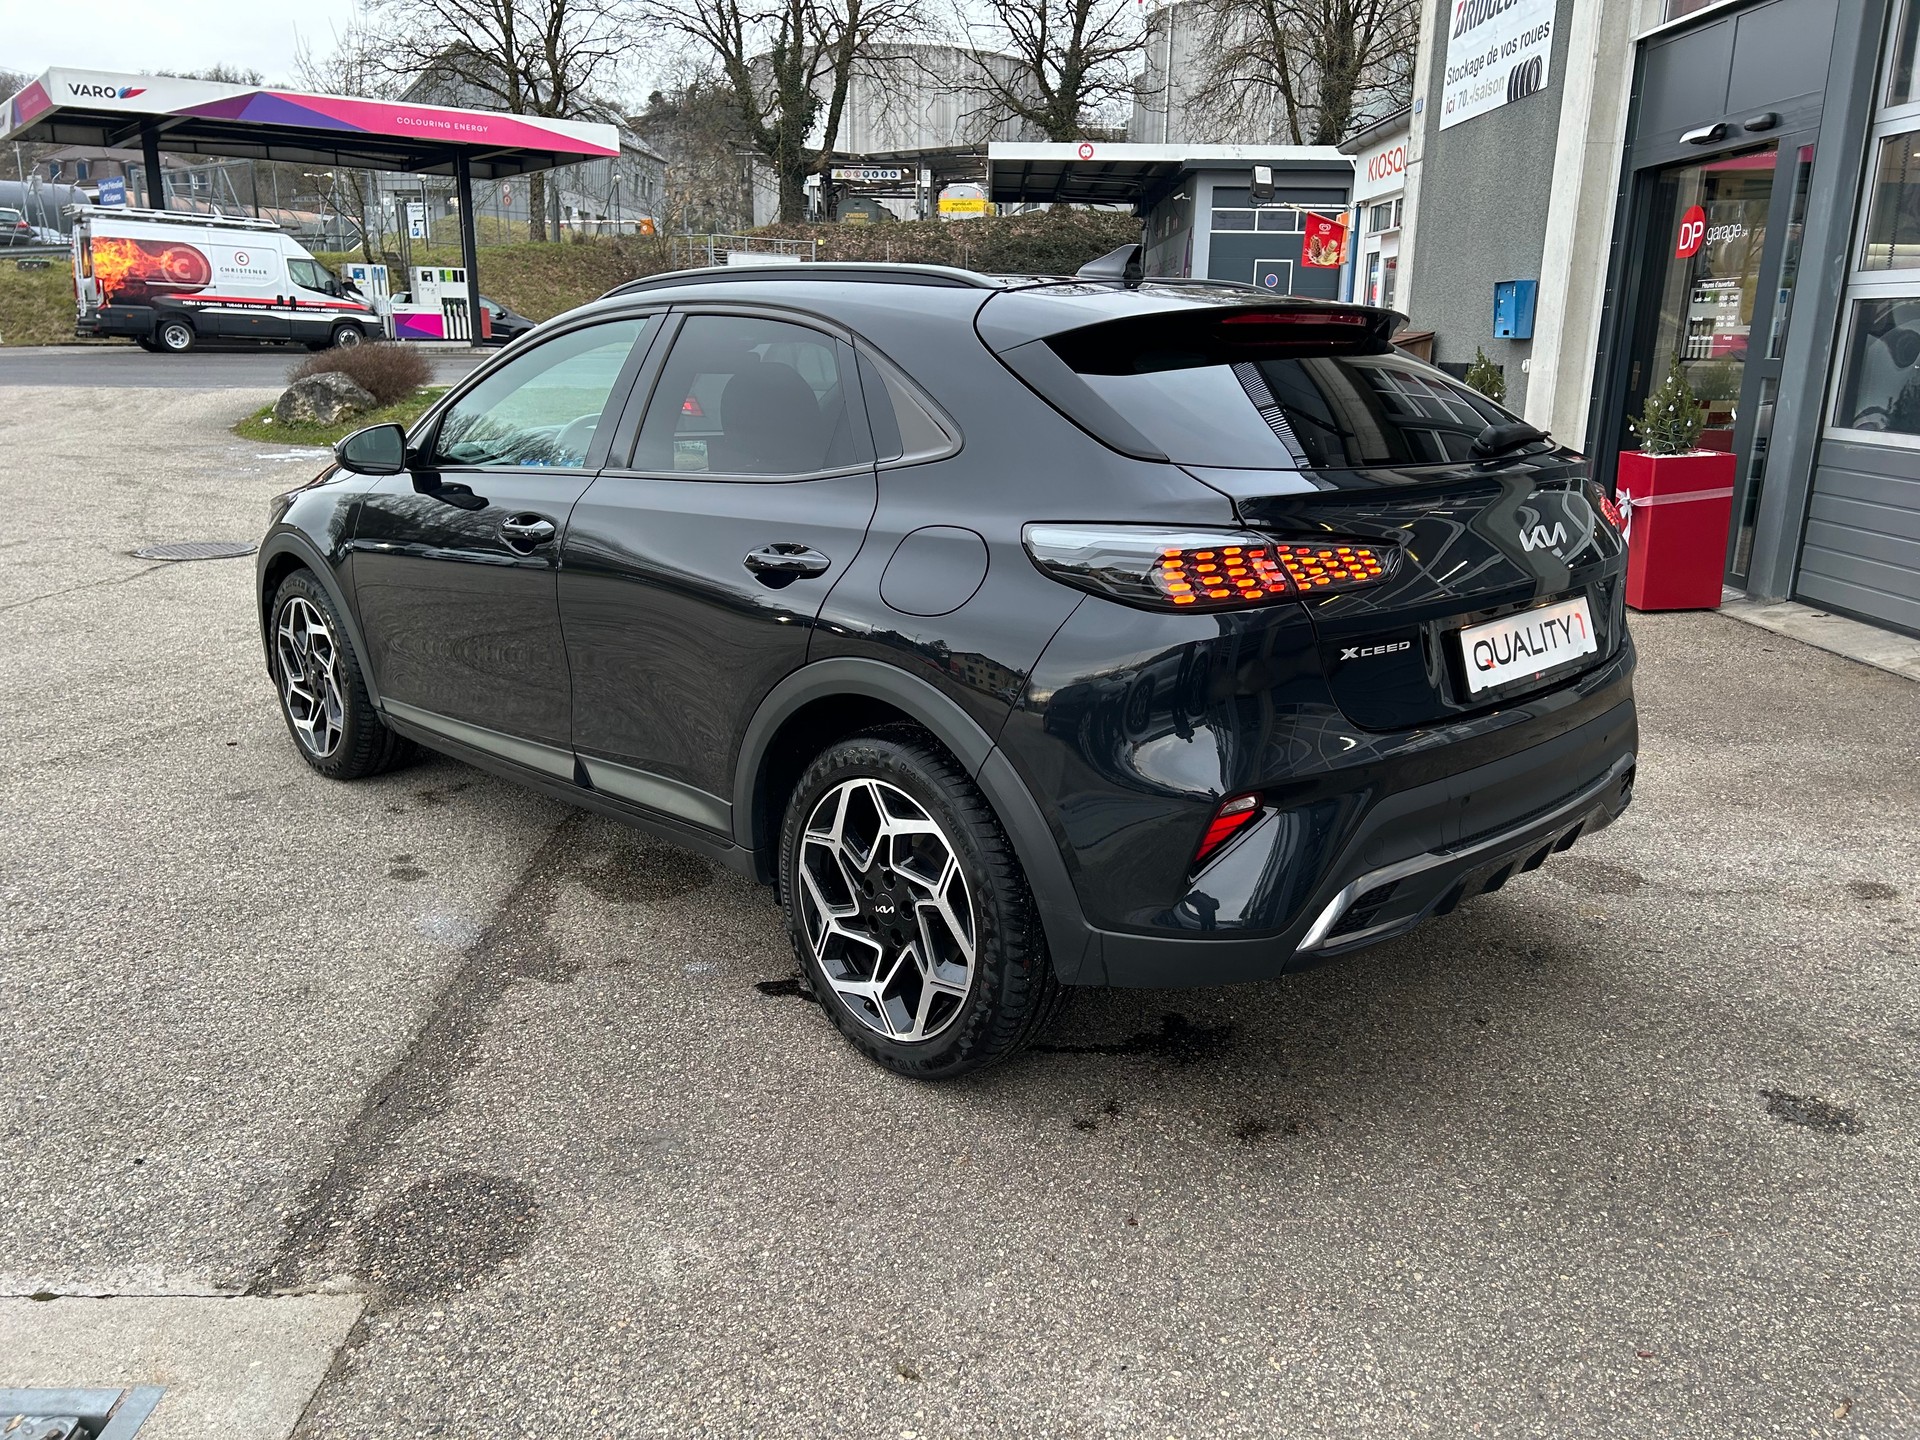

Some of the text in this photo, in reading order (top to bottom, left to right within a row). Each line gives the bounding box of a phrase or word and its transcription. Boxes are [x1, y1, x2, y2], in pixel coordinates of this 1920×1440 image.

[1446, 21, 1551, 86] Stockage de vos roues
[68, 83, 117, 99] VARO
[1445, 93, 1457, 115] ici
[396, 117, 489, 132] COLOURING ENERGY
[1679, 221, 1703, 250] DP
[1706, 223, 1742, 245] garage
[220, 266, 268, 275] CHRISTENER
[1340, 641, 1411, 661] XCEED
